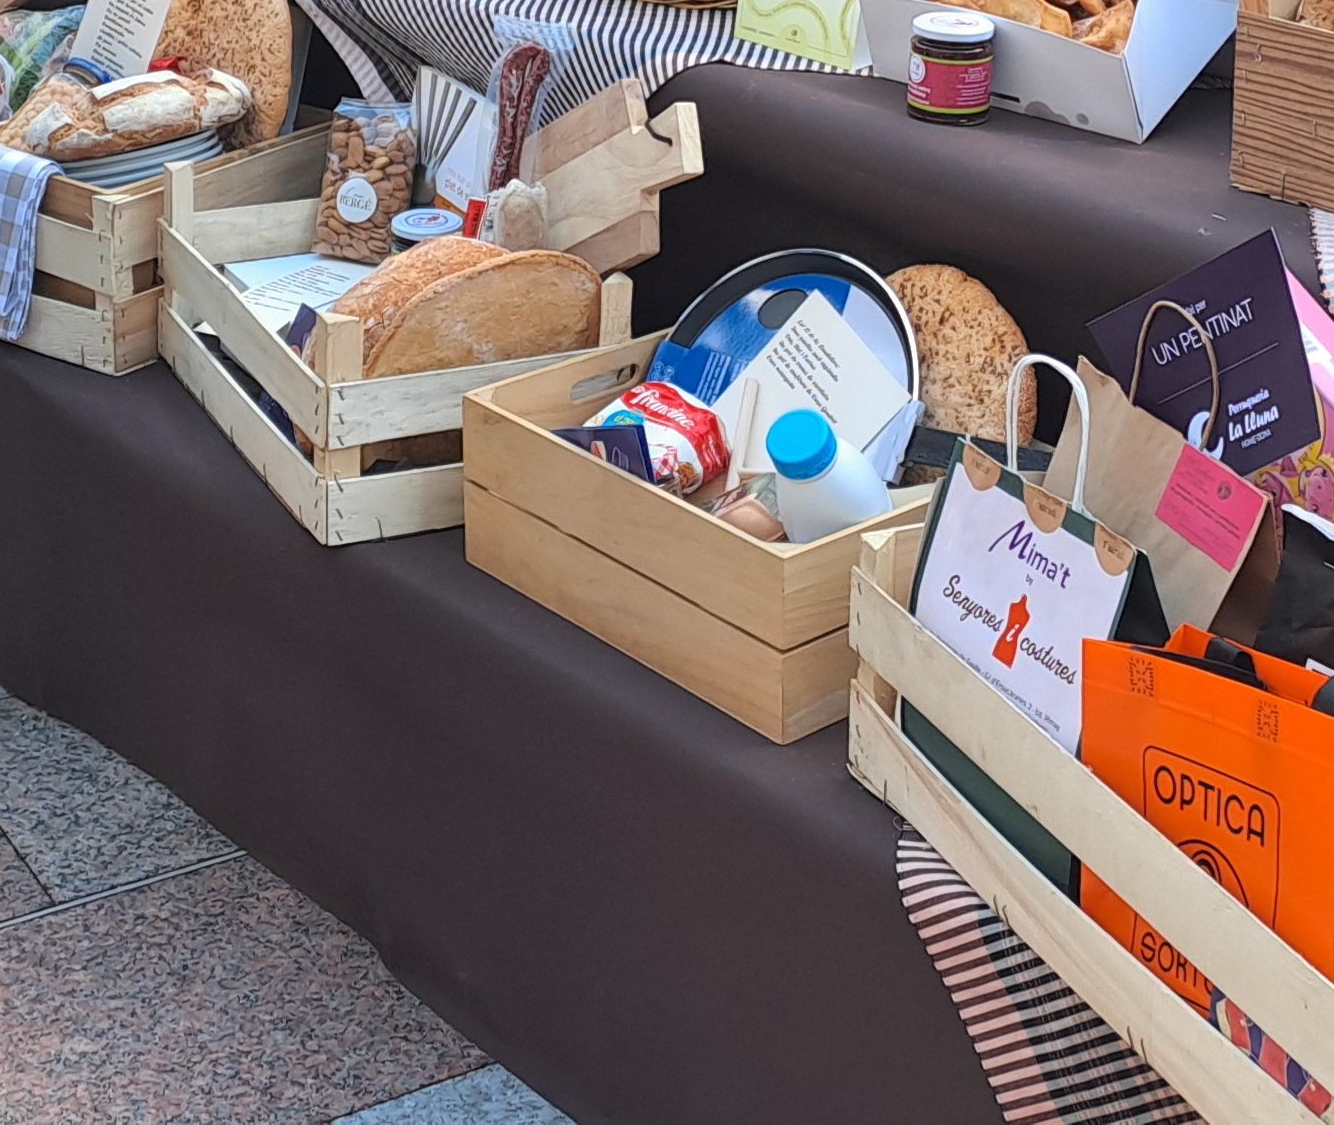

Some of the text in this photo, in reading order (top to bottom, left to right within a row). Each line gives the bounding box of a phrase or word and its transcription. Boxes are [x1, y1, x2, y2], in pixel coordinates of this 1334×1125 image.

[1151, 298, 1254, 365] UN PENTINAT
[988, 520, 1071, 589] Mima't
[1025, 573, 1034, 586] by
[942, 574, 1004, 633] Senyores
[1005, 624, 1020, 642] i
[1020, 633, 1076, 685] costures
[1154, 765, 1265, 847] OPTICA
